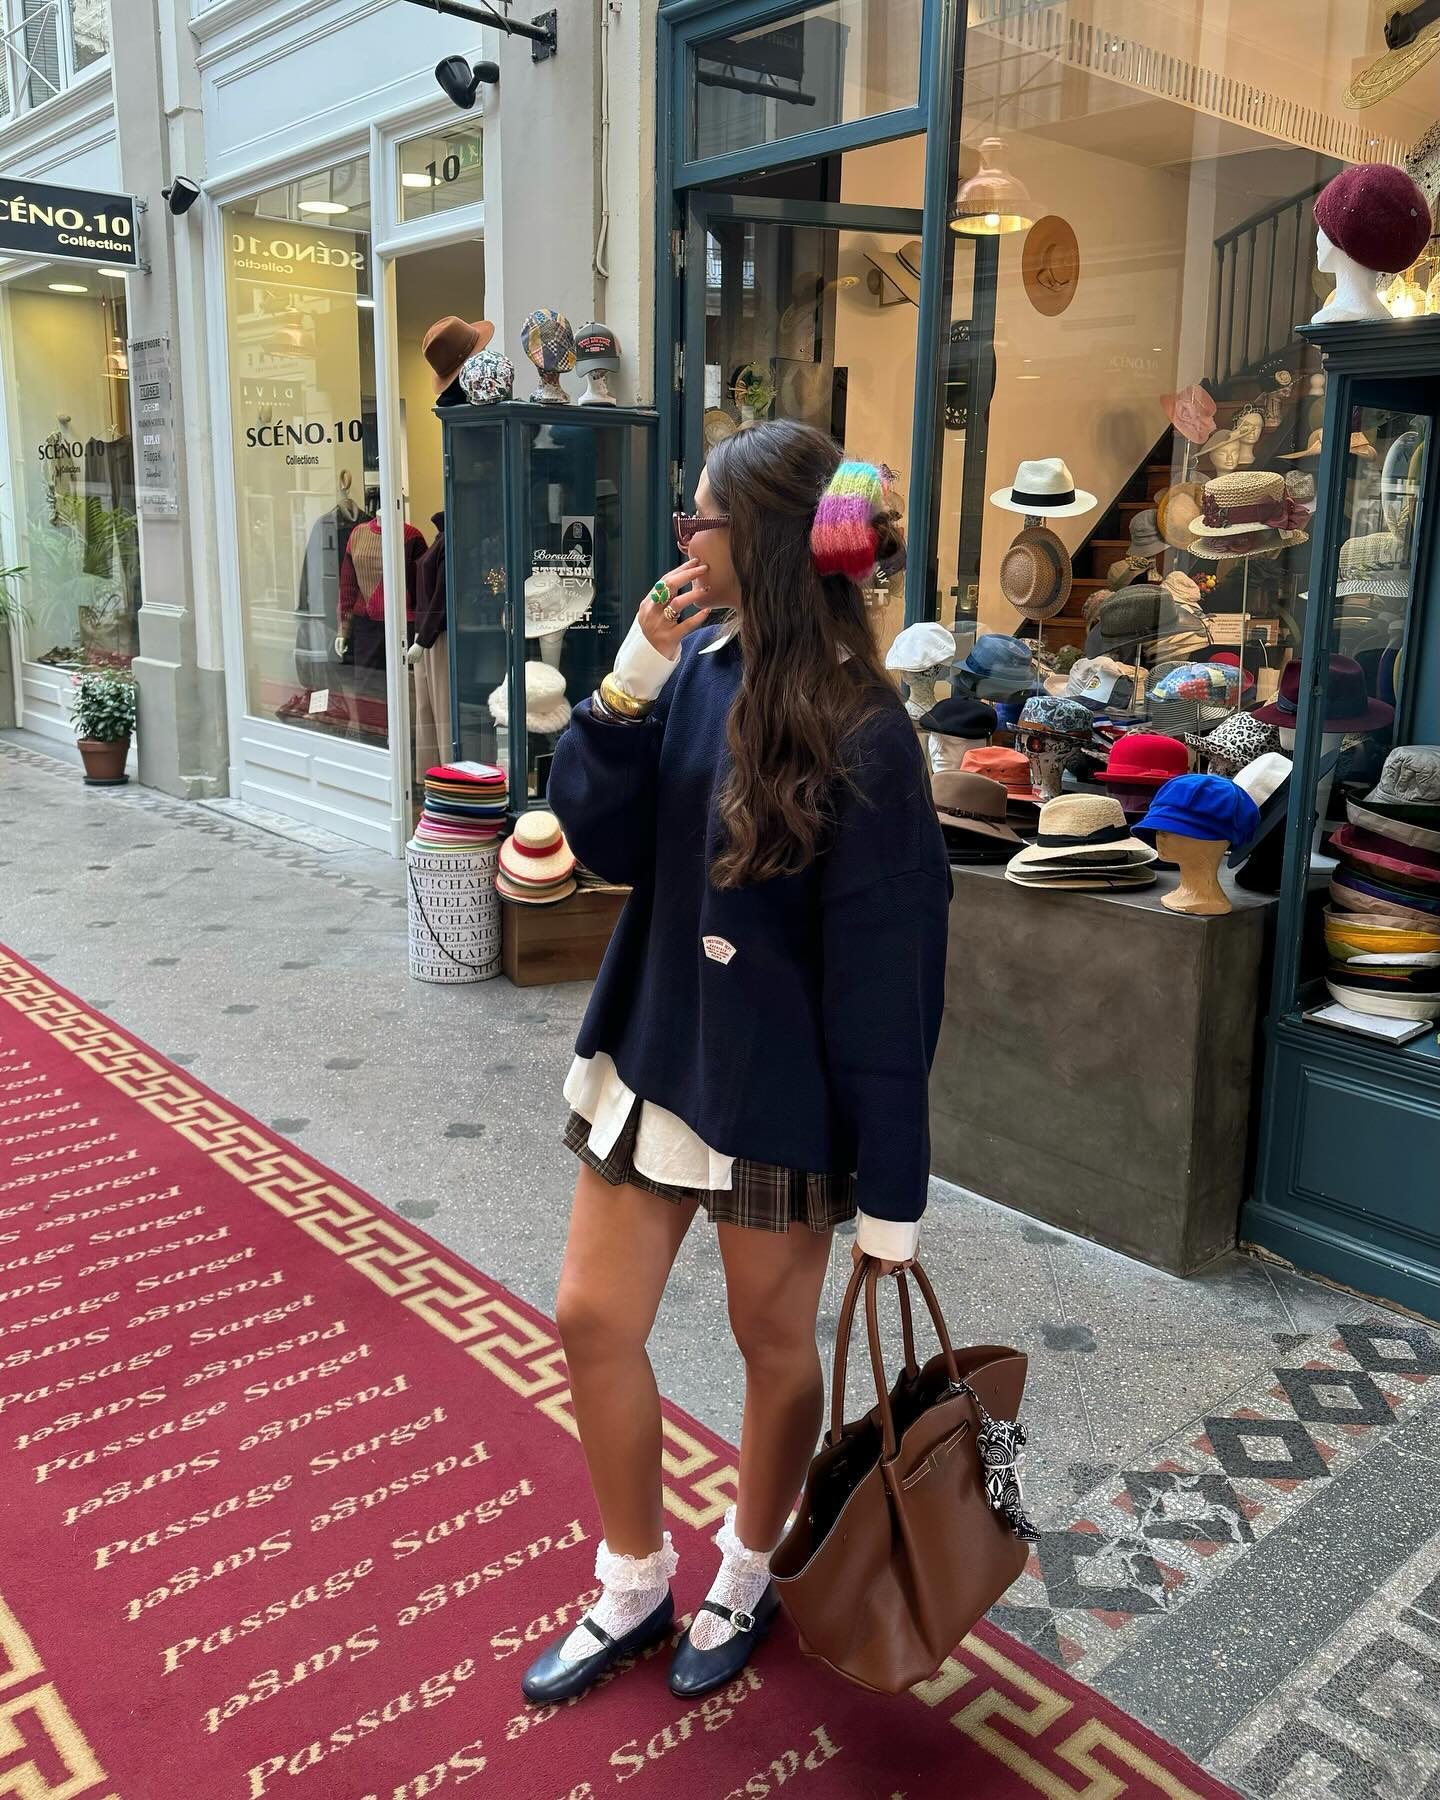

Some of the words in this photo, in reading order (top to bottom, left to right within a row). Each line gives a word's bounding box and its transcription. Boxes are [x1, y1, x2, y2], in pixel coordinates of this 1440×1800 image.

[425, 155, 460, 187] 10
[58, 233, 132, 252] Collection
[246, 419, 364, 447] SCÉNO.10
[286, 455, 319, 465] Collections
[532, 567, 592, 577] STETSON
[533, 549, 592, 563] Borsalino
[534, 579, 592, 588] GREVI
[412, 856, 478, 871] MICHEL
[11, 1133, 118, 1166] Sarget
[35, 1185, 181, 1231] Passage
[49, 1167, 160, 1204] Sarget
[78, 1226, 231, 1276] Passage
[89, 1206, 205, 1245] Sarget
[136, 1247, 255, 1293] Sarget
[127, 1270, 285, 1328] Passage
[190, 1294, 315, 1346] Sarget
[183, 1320, 348, 1387] Passage
[12, 1385, 167, 1450] Sarget
[32, 1402, 227, 1484] Passage
[244, 1344, 372, 1402] Sarget
[238, 1374, 409, 1450] Passage
[61, 1450, 220, 1526] Sarget
[93, 1475, 292, 1570] Passage
[309, 1407, 447, 1475] Sarget
[311, 1441, 492, 1532] Passage
[122, 1529, 292, 1621] Sarget
[161, 1558, 374, 1676] Passage
[390, 1479, 535, 1560] Sarget
[397, 1519, 591, 1626] Passage
[200, 1625, 380, 1735] Sarget
[242, 1659, 476, 1800] Passage
[608, 1666, 765, 1785] Sarget
